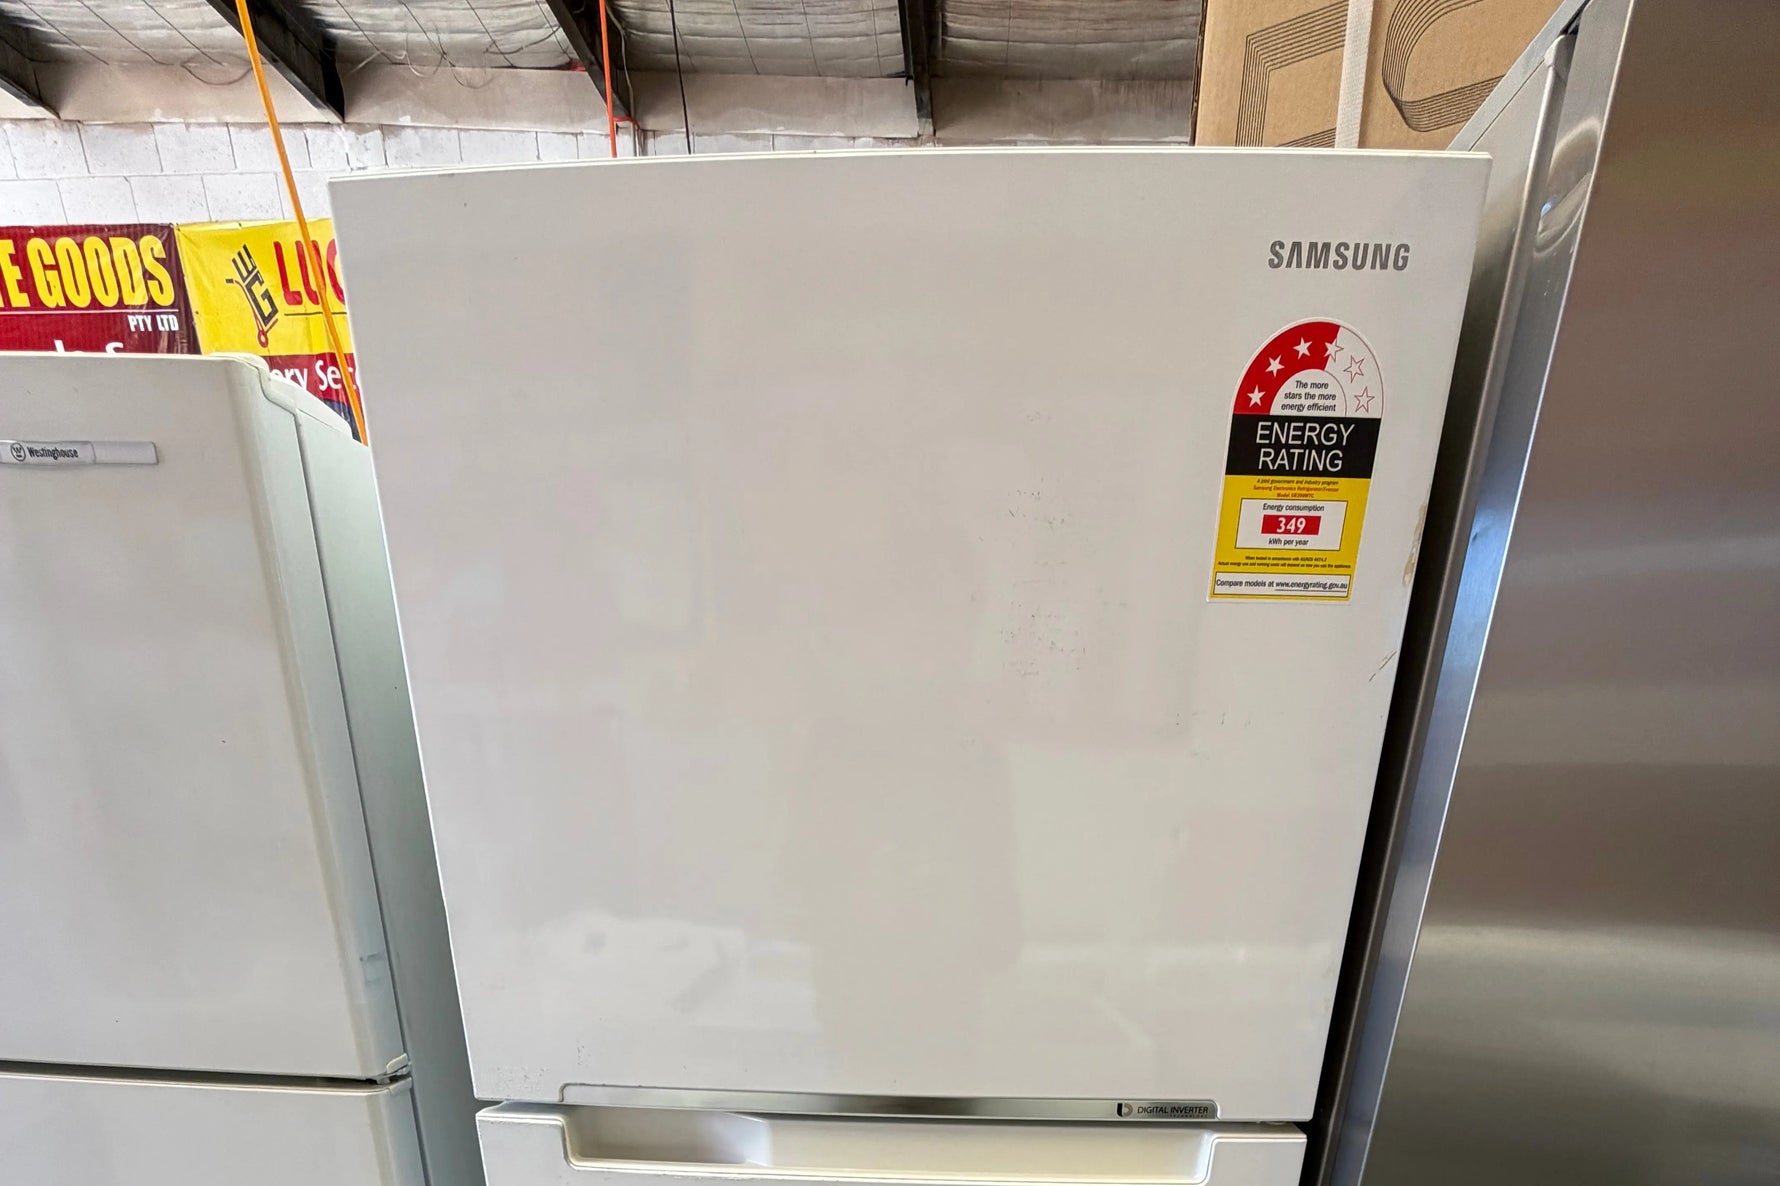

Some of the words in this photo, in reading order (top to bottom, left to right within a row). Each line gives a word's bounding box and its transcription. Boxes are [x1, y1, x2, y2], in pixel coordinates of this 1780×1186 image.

[1268, 240, 1410, 271] SAMSUNG
[26, 235, 175, 308] GOODS
[128, 314, 152, 332] PTY
[156, 314, 179, 331] LTD
[1295, 380, 1308, 389] The
[1310, 382, 1329, 390] more
[1284, 391, 1302, 400] stars
[1304, 391, 1316, 400] the
[1318, 393, 1336, 401] more
[1281, 403, 1305, 412] energy
[1307, 403, 1336, 412] efficient
[1256, 421, 1355, 446] ENERGY
[27, 446, 79, 460] Westinghouse
[1258, 448, 1343, 472] RATING
[1262, 503, 1285, 512] Energy
[1285, 504, 1325, 512] consumption
[1276, 517, 1306, 533] 349
[1268, 537, 1282, 545] kWh
[1283, 538, 1294, 546] per
[1216, 579, 1243, 588] Compare
[1275, 581, 1348, 590] www.energyrating.gov.au
[1137, 1106, 1169, 1114] DIGITAL
[1170, 1106, 1209, 1114] INVERTER
